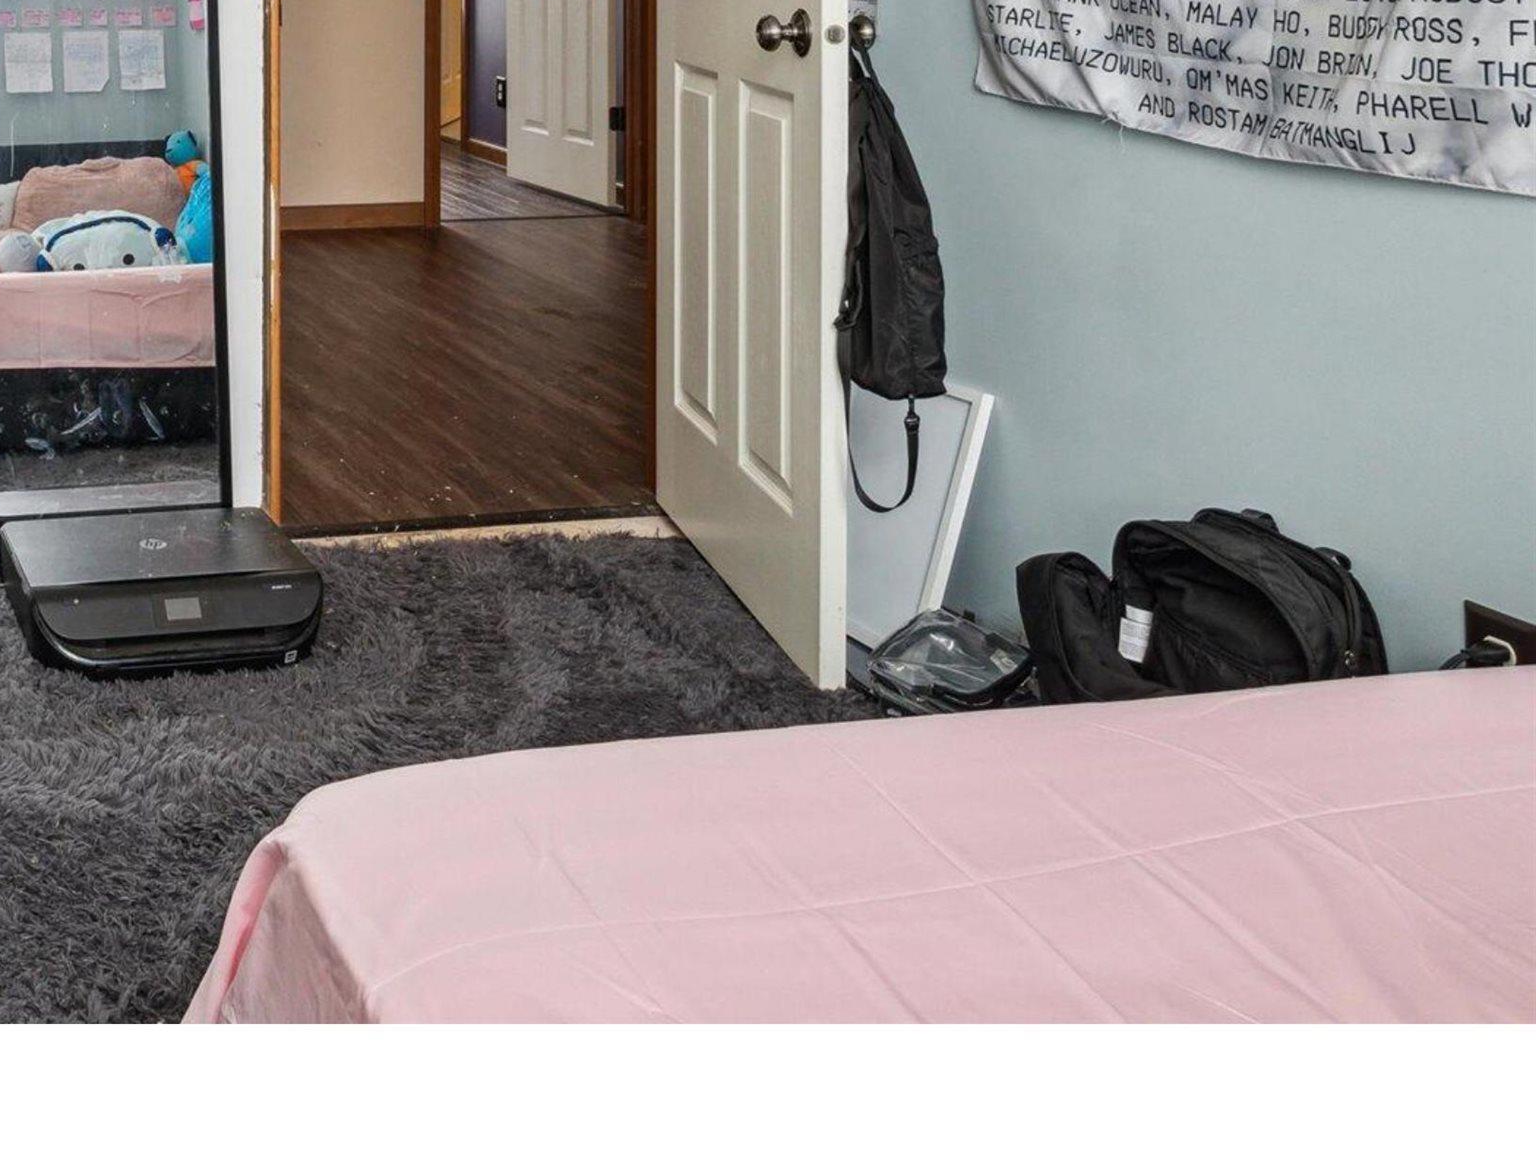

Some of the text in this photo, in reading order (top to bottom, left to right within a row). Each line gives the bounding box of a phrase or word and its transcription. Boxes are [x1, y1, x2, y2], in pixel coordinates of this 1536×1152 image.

[1186, 1, 1258, 29] MALAY
[1273, 9, 1309, 36] HO,
[1393, 16, 1480, 46] ROSS,
[1104, 21, 1156, 49] JAMES
[1168, 32, 1242, 65] BLACK,
[1262, 45, 1305, 71] JON
[1401, 57, 1454, 83] JOE
[1138, 93, 1175, 118] AND
[1188, 101, 1267, 135] ROSTAM
[1186, 68, 1268, 100] OM'MAS
[1283, 83, 1338, 113] KEITH,
[1356, 90, 1489, 125] PHARELL
[1511, 102, 1531, 128] W
